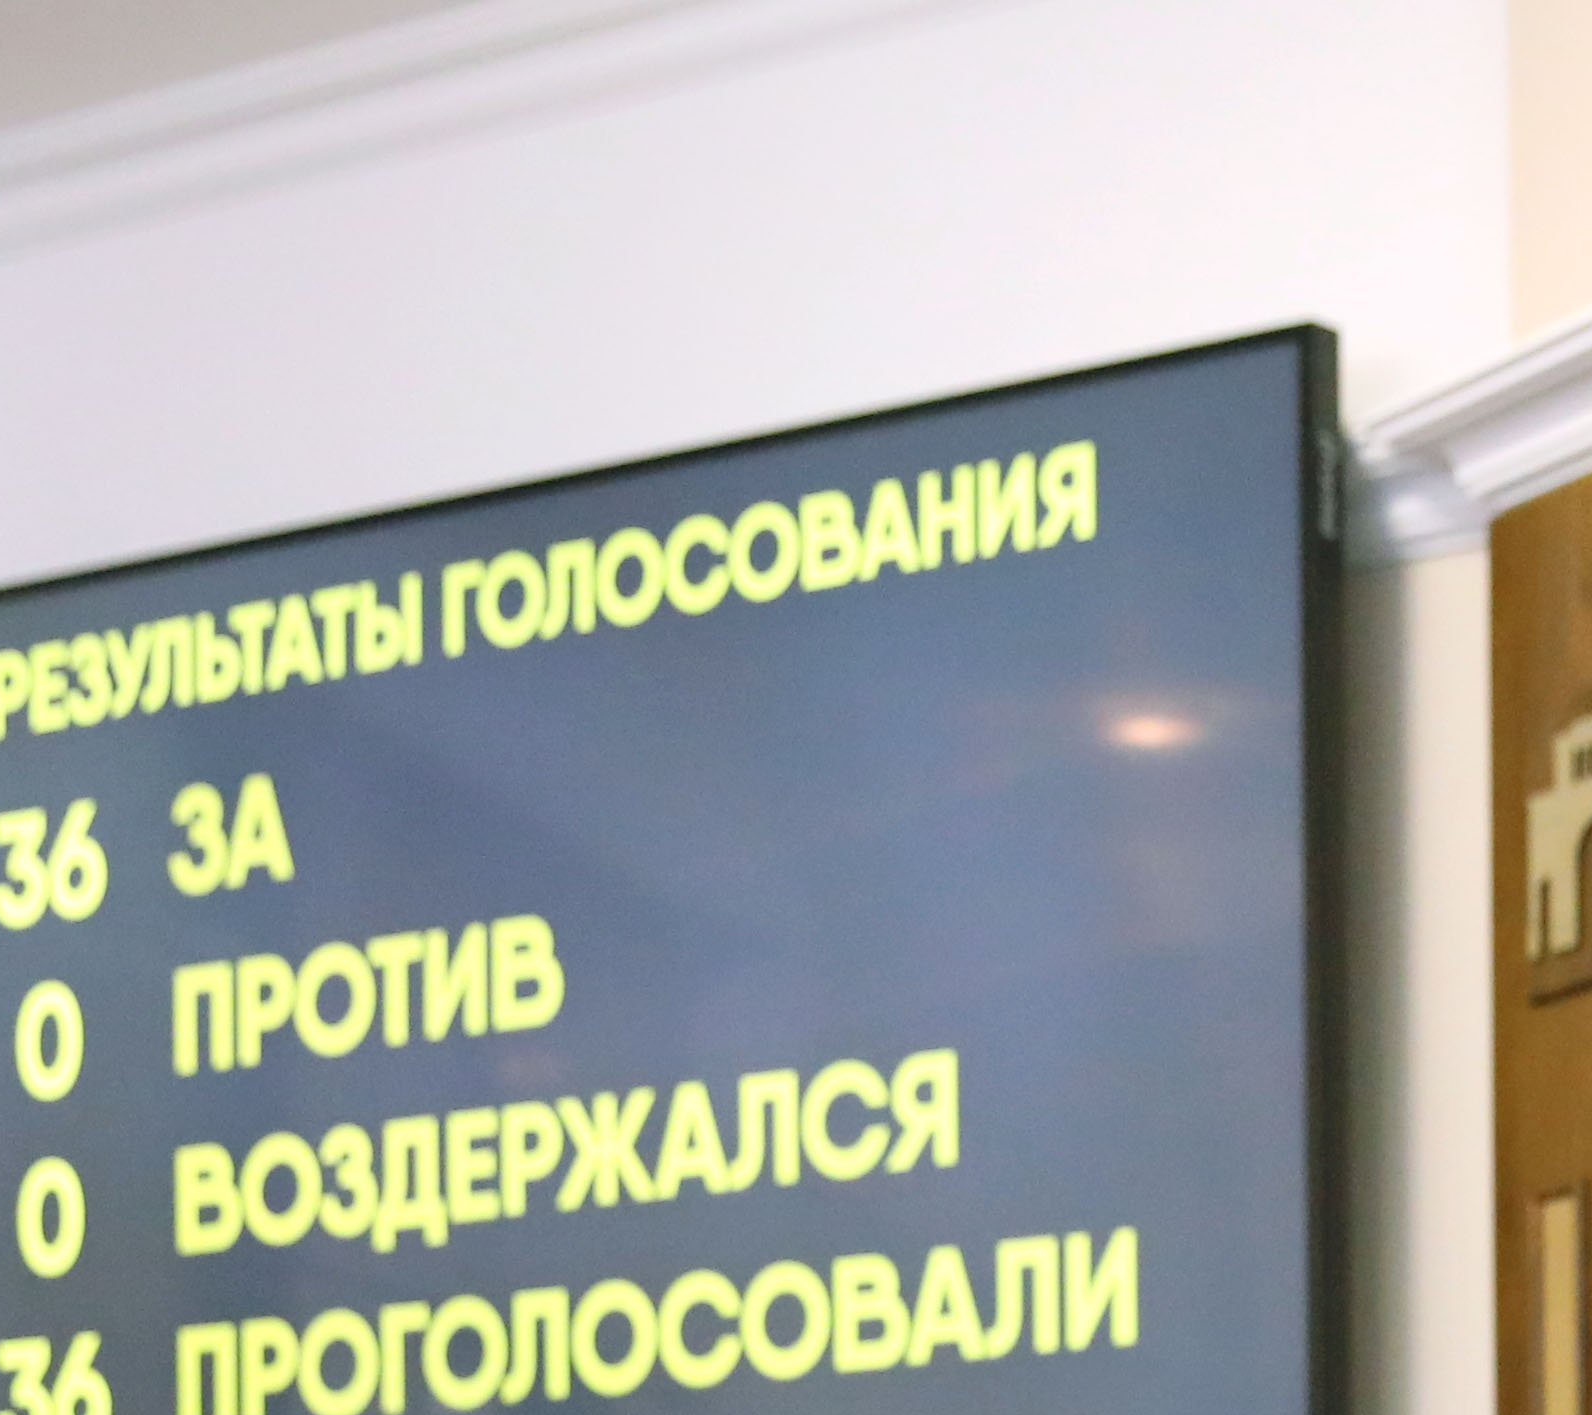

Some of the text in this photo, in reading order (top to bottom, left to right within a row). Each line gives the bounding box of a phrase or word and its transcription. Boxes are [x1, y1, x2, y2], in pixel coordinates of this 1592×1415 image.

[441, 439, 1100, 658] ГОЛОСОВАНИЯ
[166, 774, 296, 898] ЗА
[12, 914, 567, 1104] 0 ПРОТИВ
[13, 1048, 962, 1280] 0 ВОЗДЕРЖАЛСЯ
